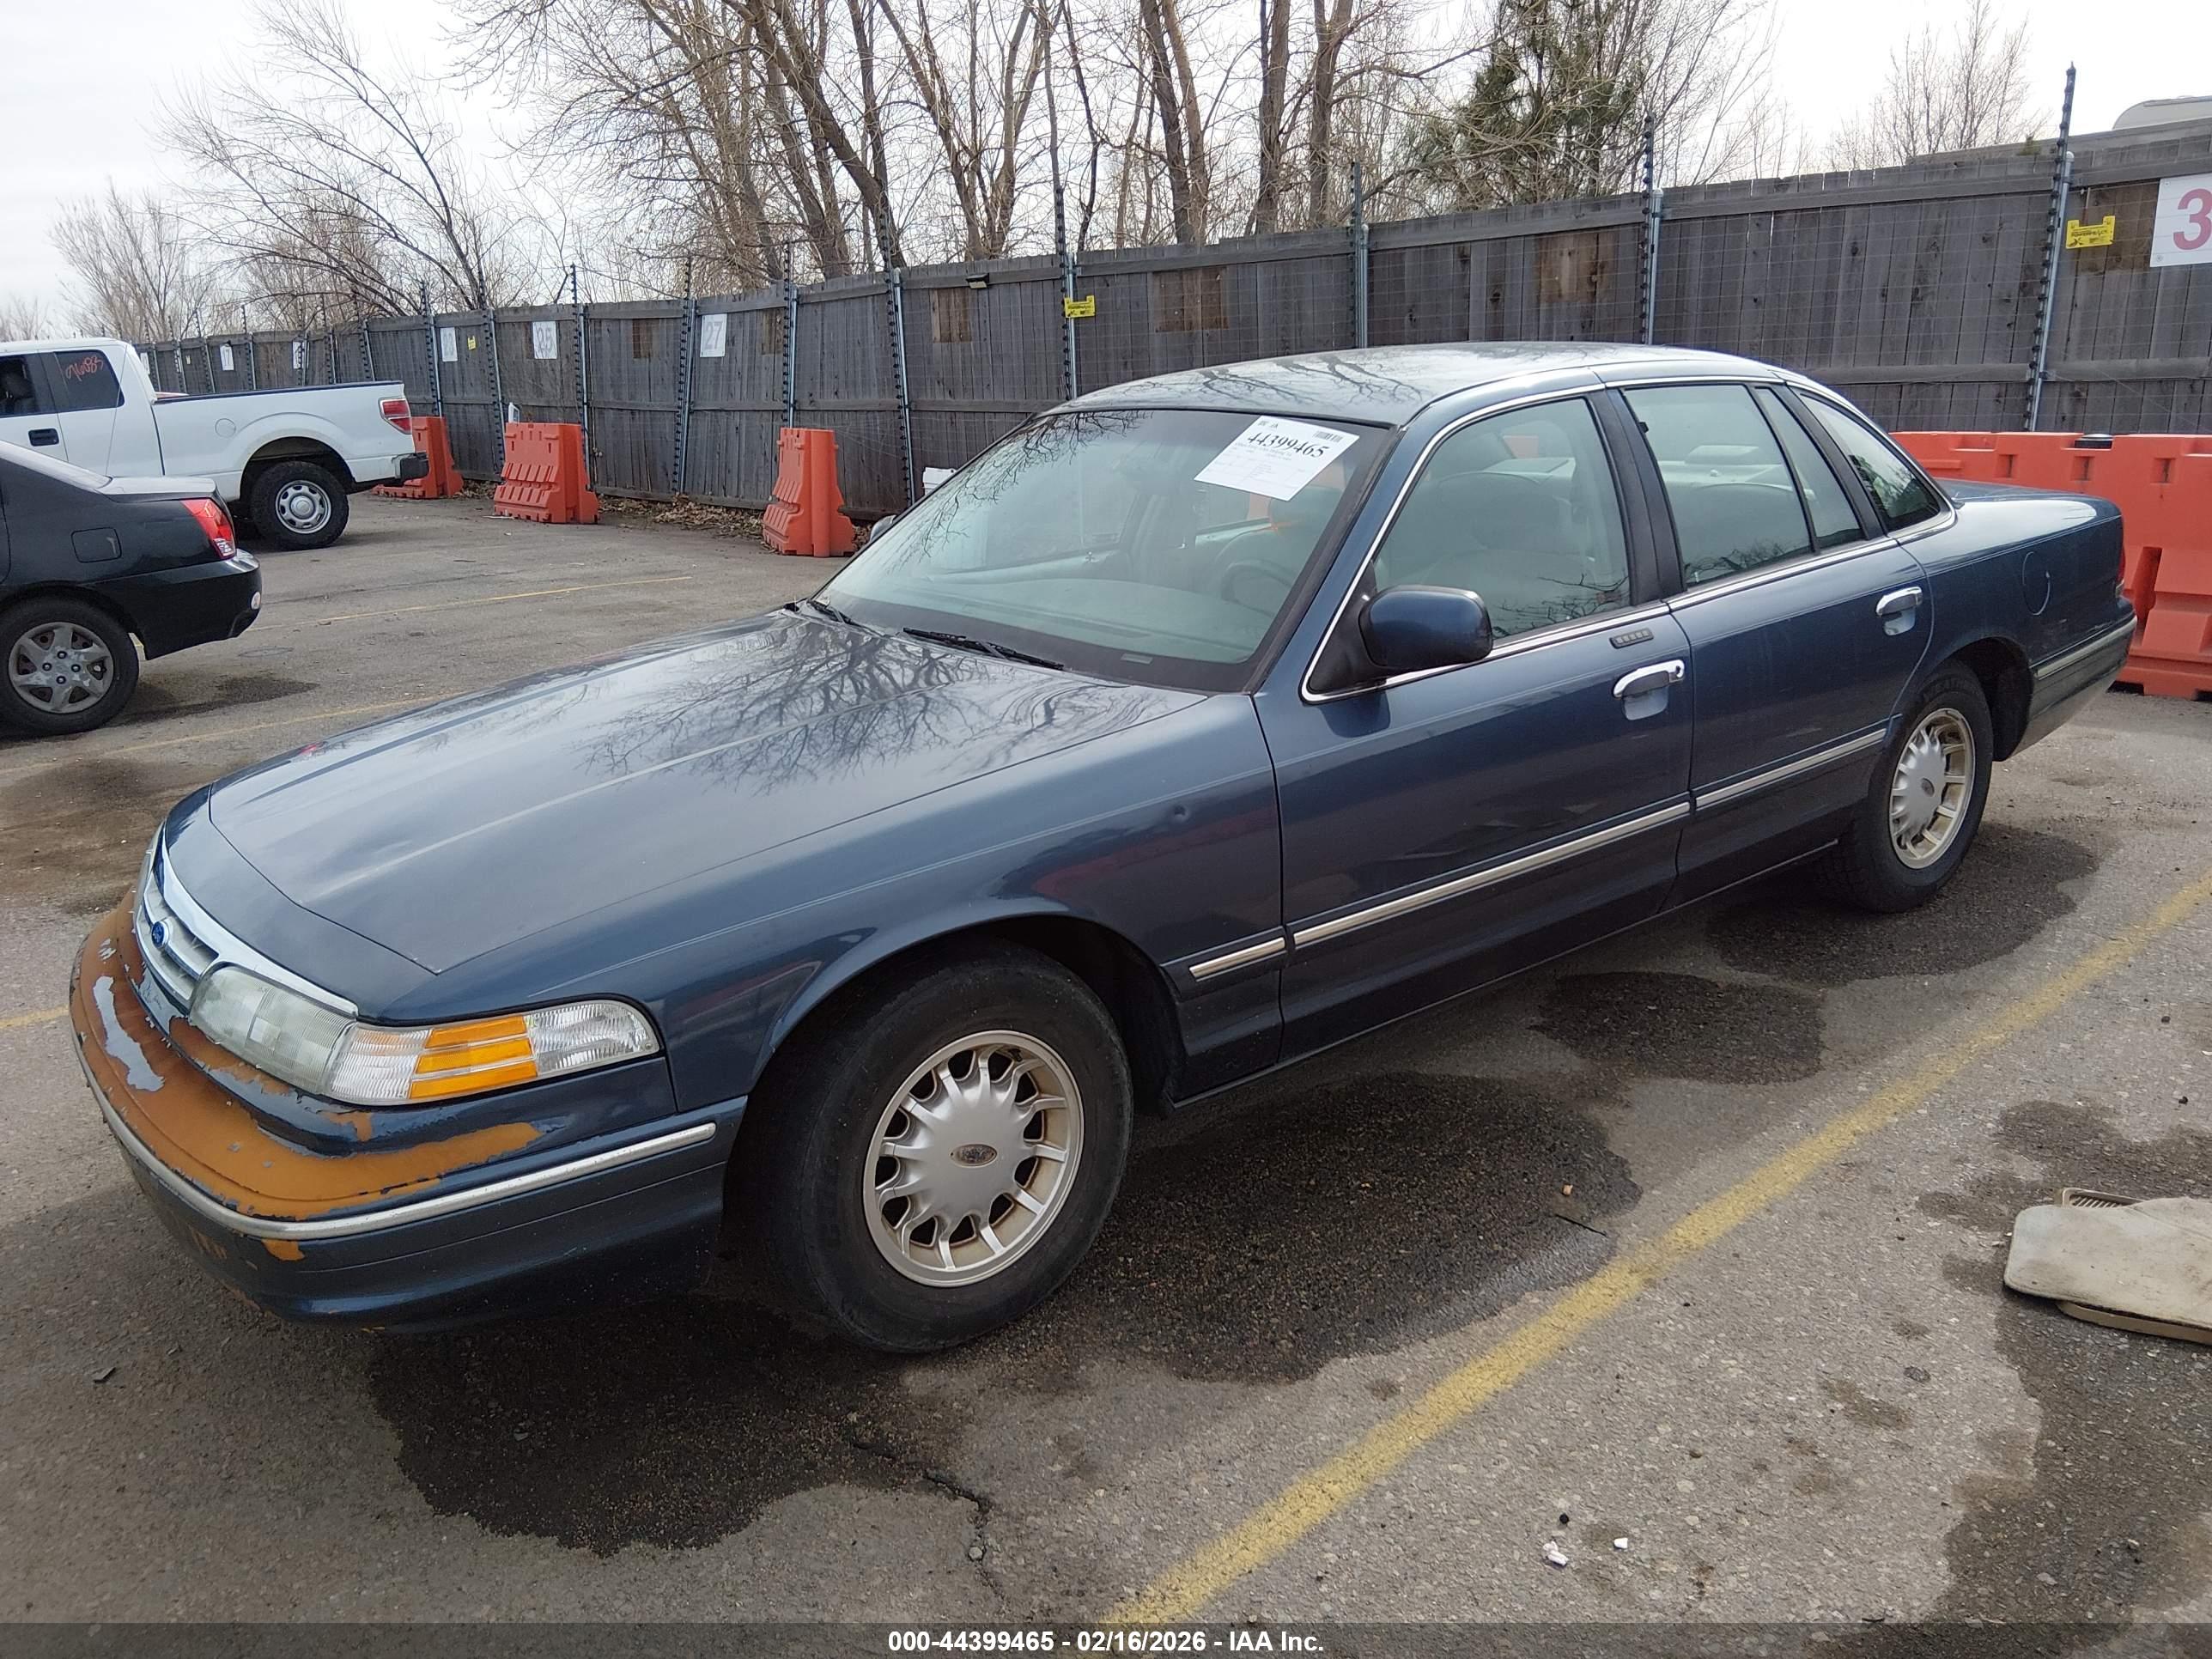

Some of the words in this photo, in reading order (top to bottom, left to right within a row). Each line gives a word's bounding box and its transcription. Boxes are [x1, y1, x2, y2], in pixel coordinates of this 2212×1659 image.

[2172, 188, 2212, 251] 3
[704, 321, 723, 350] 27
[1248, 432, 1330, 458] 44399465
